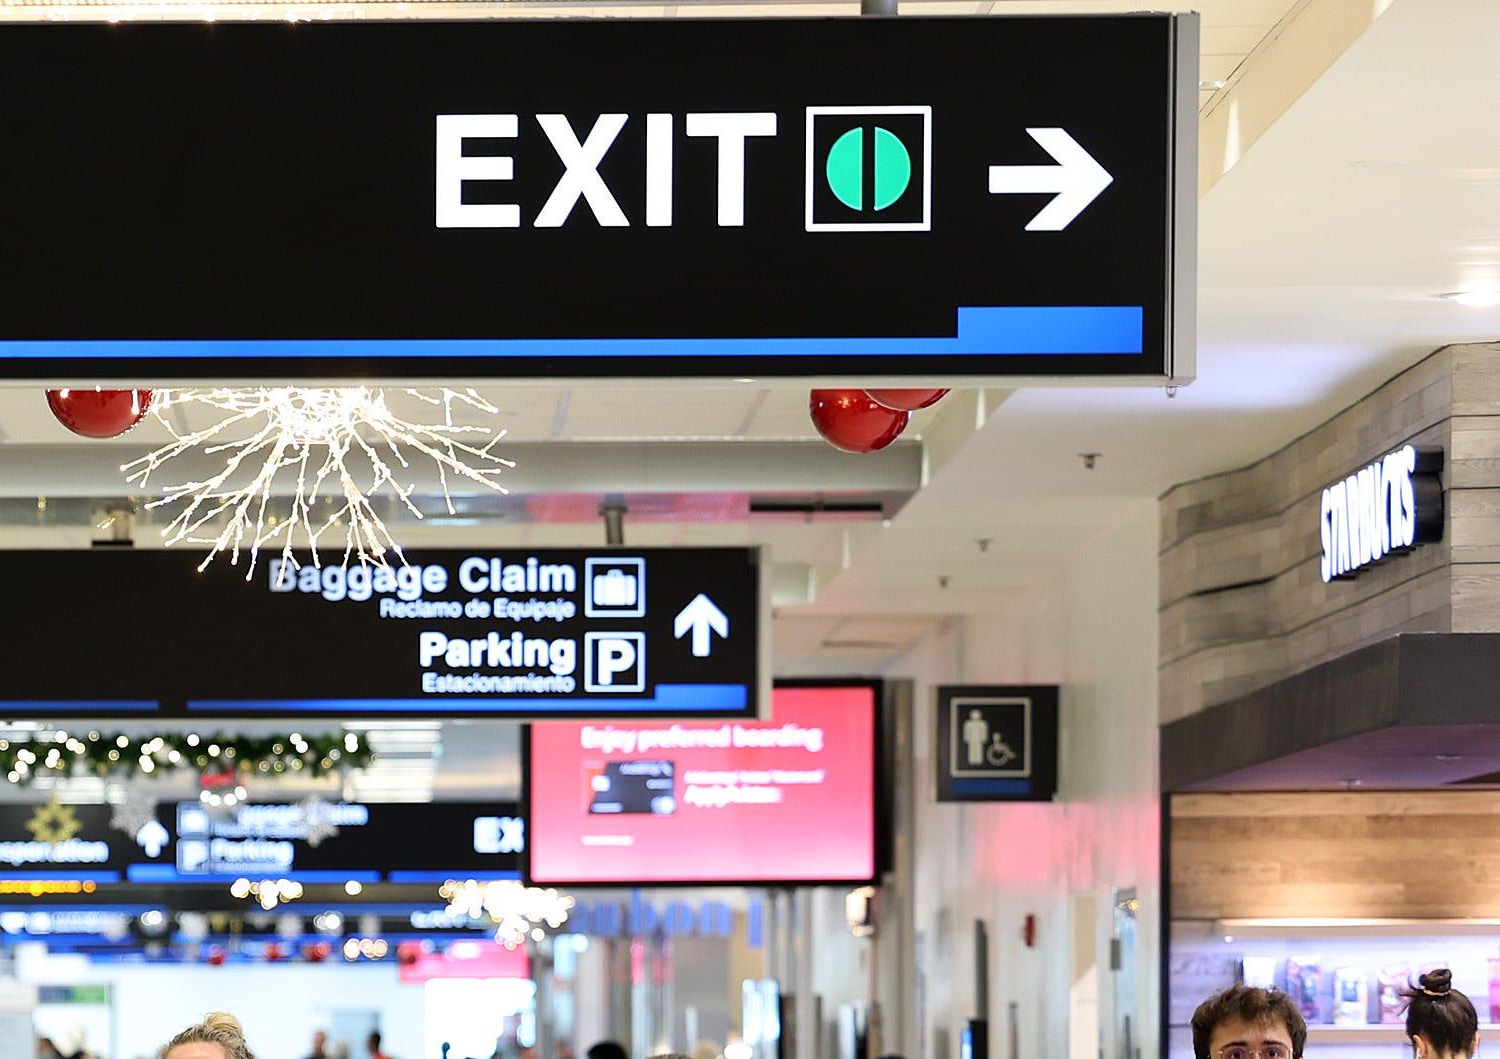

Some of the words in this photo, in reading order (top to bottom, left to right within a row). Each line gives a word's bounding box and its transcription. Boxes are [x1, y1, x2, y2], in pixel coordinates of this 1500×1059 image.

[435, 112, 777, 228] EXIT
[268, 558, 448, 602] Baggage
[458, 557, 576, 593] Claim
[379, 597, 462, 619] Reclamo
[464, 598, 490, 619] de
[492, 598, 576, 620] Equipaje
[419, 630, 576, 676] Parking
[421, 672, 576, 694] Estacionamiento
[473, 816, 524, 854] EX
